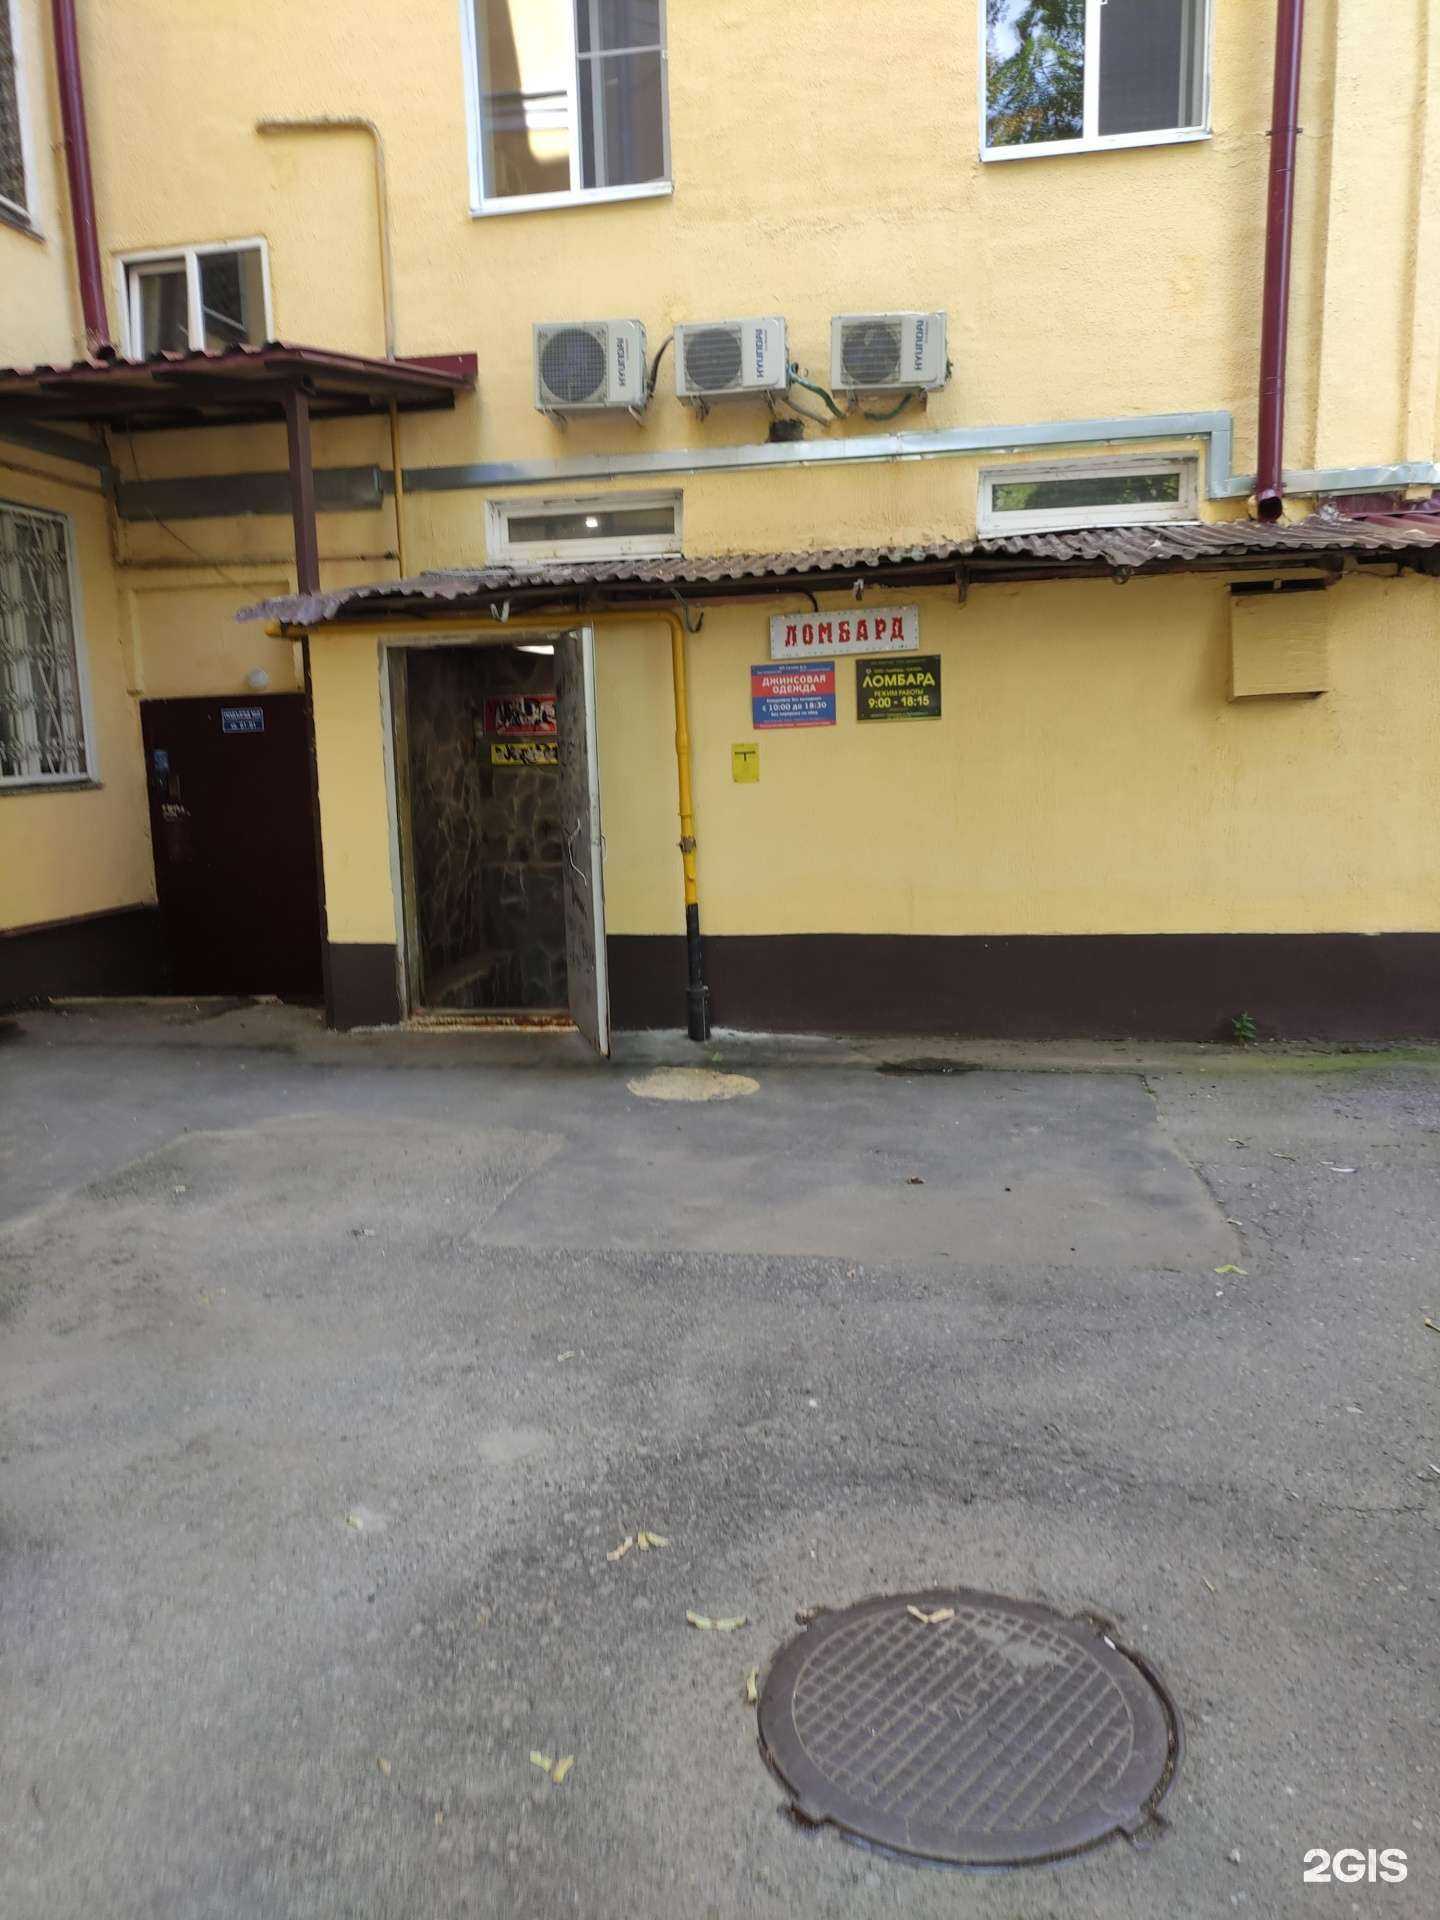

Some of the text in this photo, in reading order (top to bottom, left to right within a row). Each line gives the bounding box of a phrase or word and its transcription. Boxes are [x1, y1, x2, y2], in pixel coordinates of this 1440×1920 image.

[914, 320, 924, 370] HYUNDAI
[785, 616, 904, 647] ЛОМБАРД
[762, 674, 827, 688] ДЖИНСОВАЯ
[862, 672, 936, 688] ЛОМБАРД
[772, 684, 816, 695] ОДЕЖДА
[868, 697, 891, 709] 9:00
[901, 695, 930, 707] 18:15
